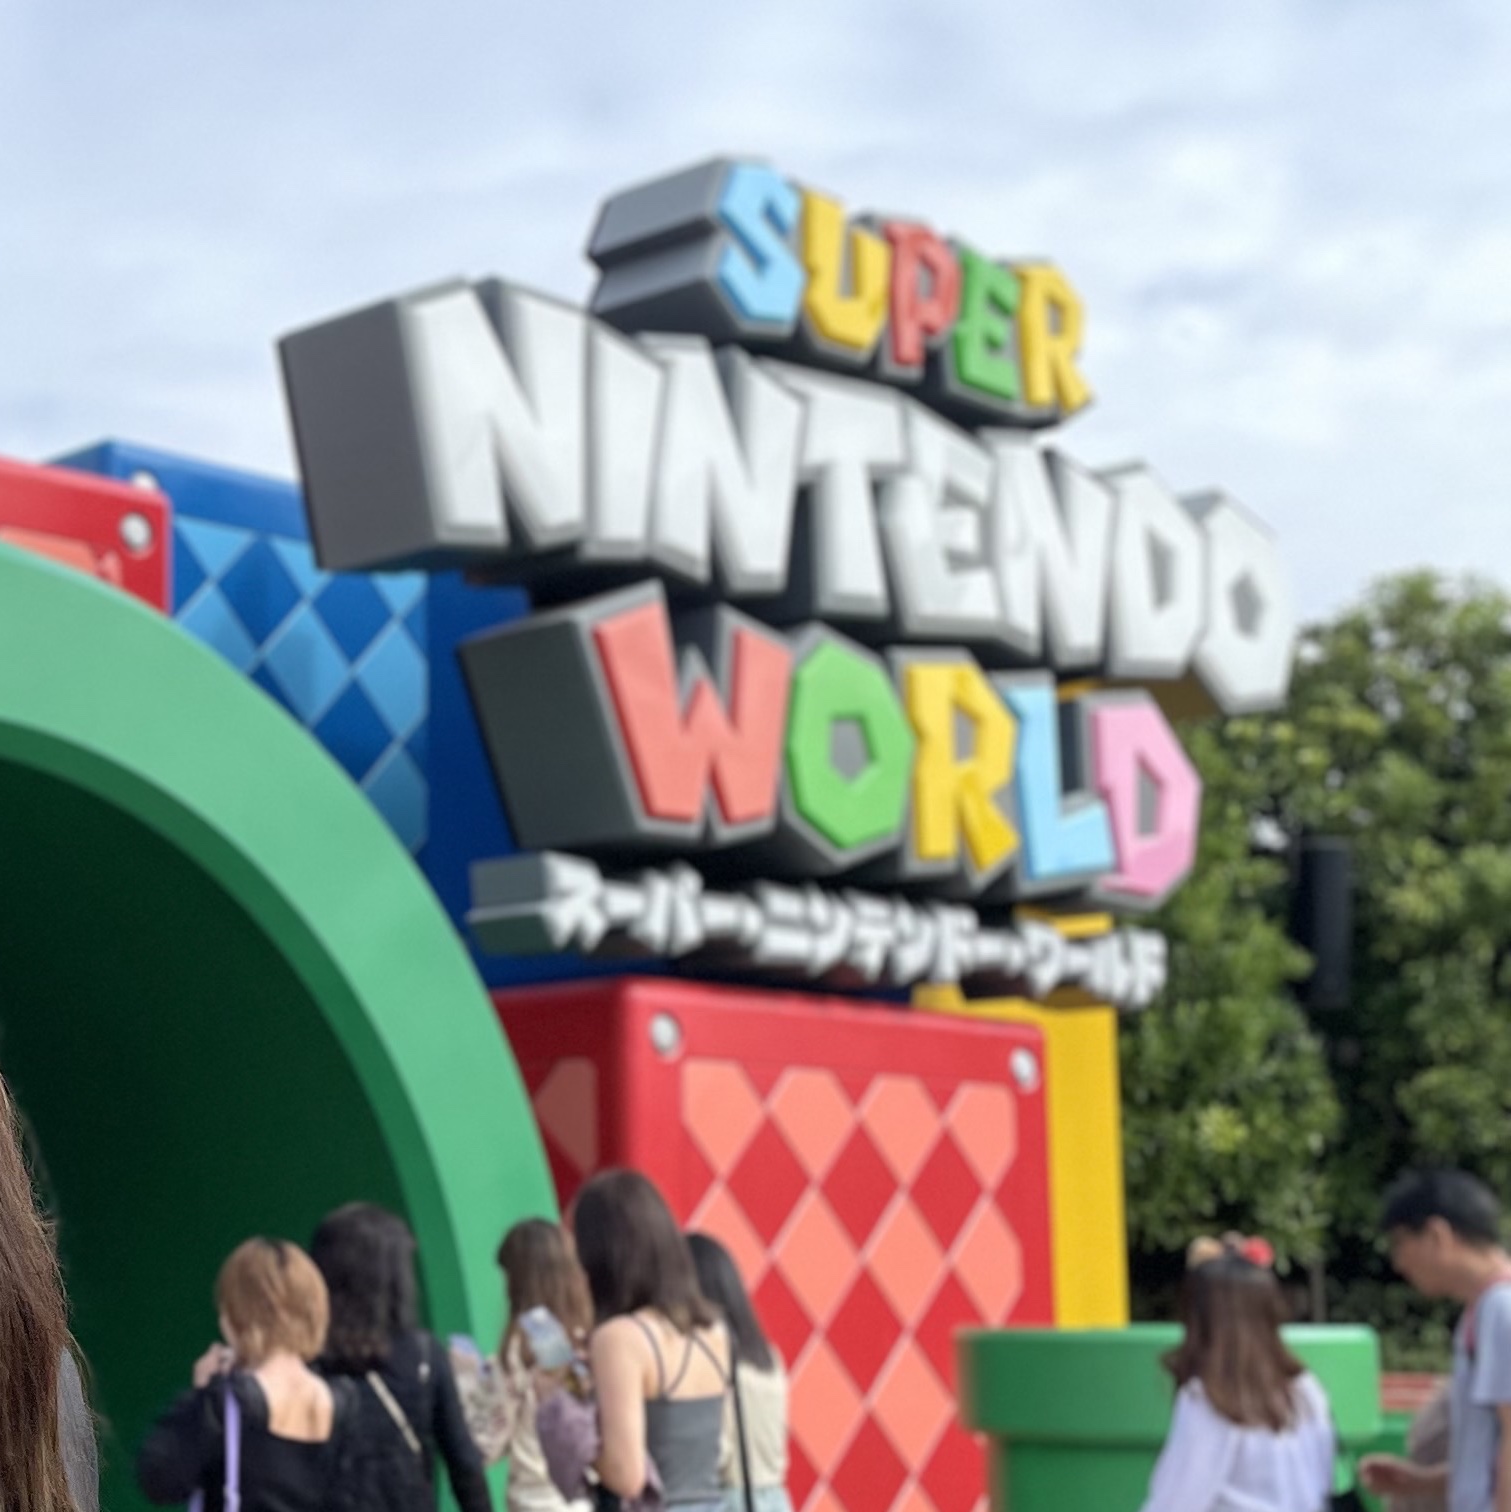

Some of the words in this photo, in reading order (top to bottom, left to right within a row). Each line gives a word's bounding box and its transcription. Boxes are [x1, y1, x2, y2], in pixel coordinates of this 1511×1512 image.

[717, 158, 1092, 414] SUPER
[398, 276, 1296, 714] NINTENDO
[591, 598, 1202, 898] WORLD
